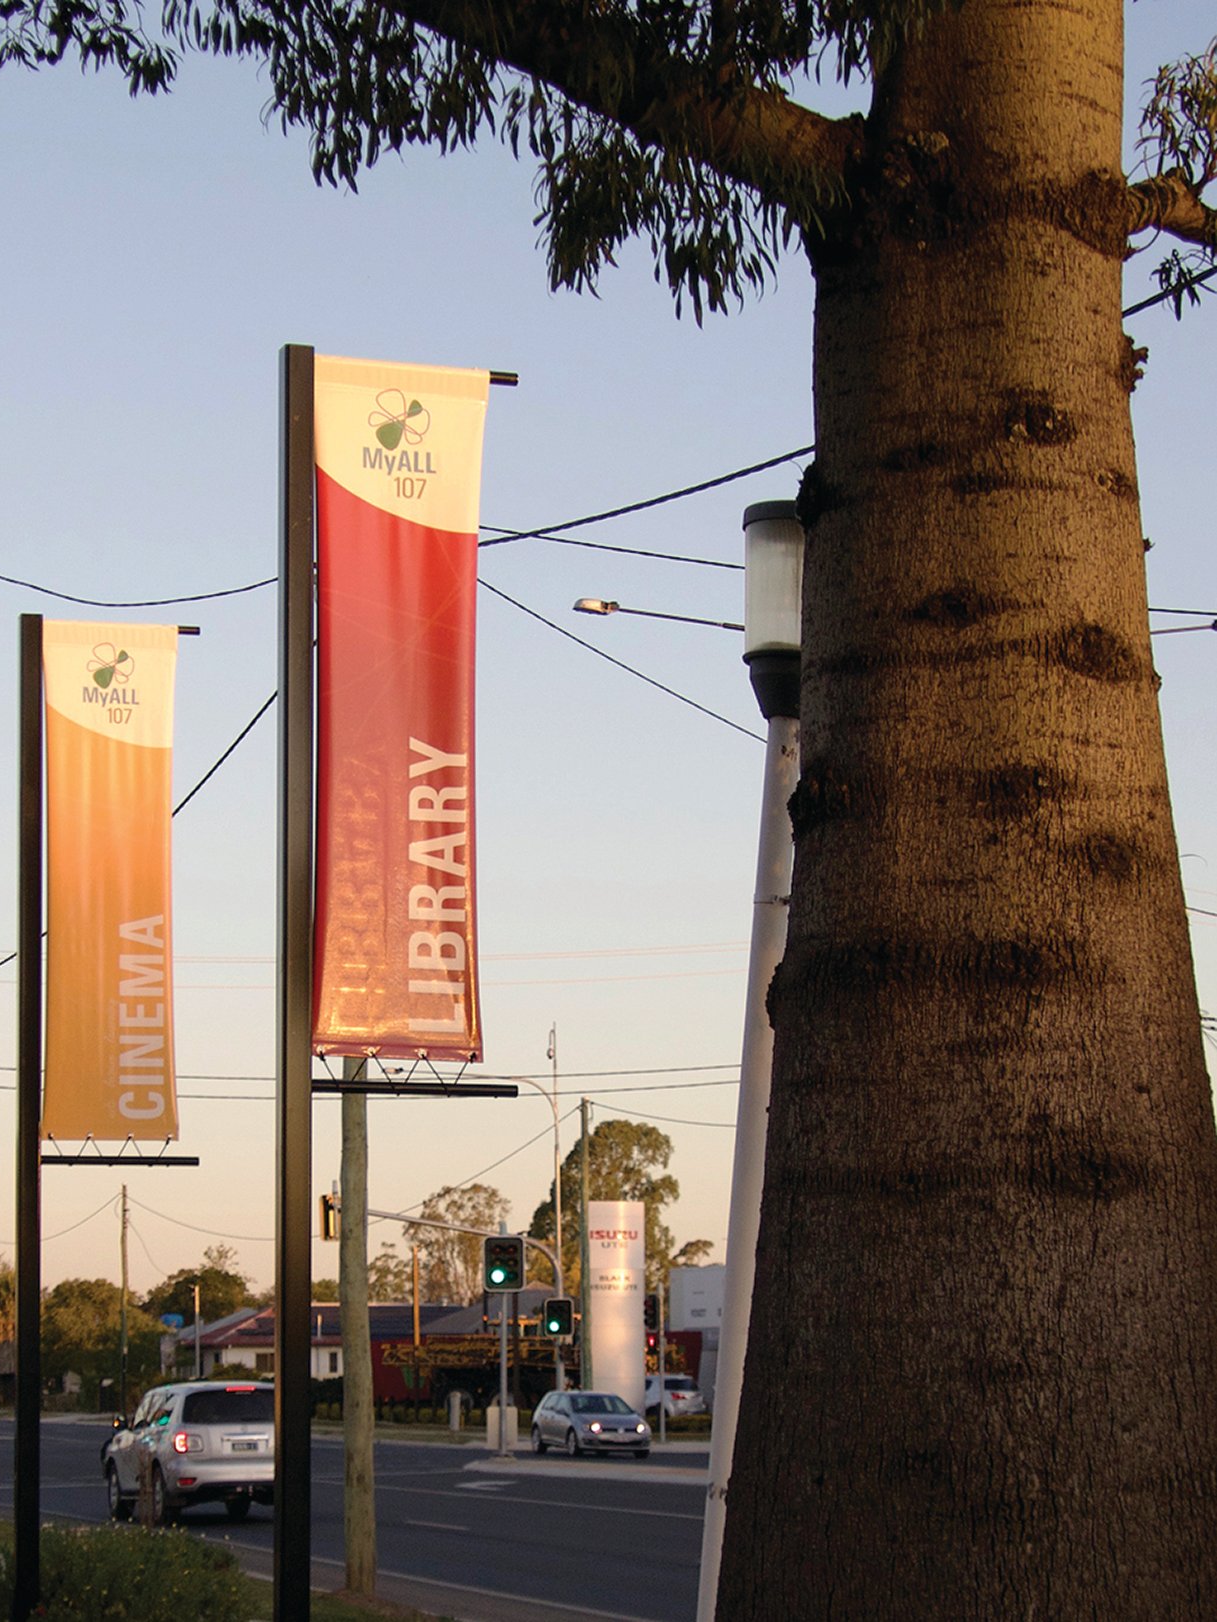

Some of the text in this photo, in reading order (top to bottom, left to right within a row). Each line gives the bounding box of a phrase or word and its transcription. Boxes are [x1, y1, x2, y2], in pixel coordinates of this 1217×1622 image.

[362, 447, 436, 475] MyALL
[394, 477, 427, 499] 107
[82, 686, 140, 707] MyALL
[107, 708, 133, 724] 107
[408, 736, 468, 1033] LIBRARY
[118, 914, 165, 1120] CINEMA
[590, 1230, 638, 1240] ISUZU
